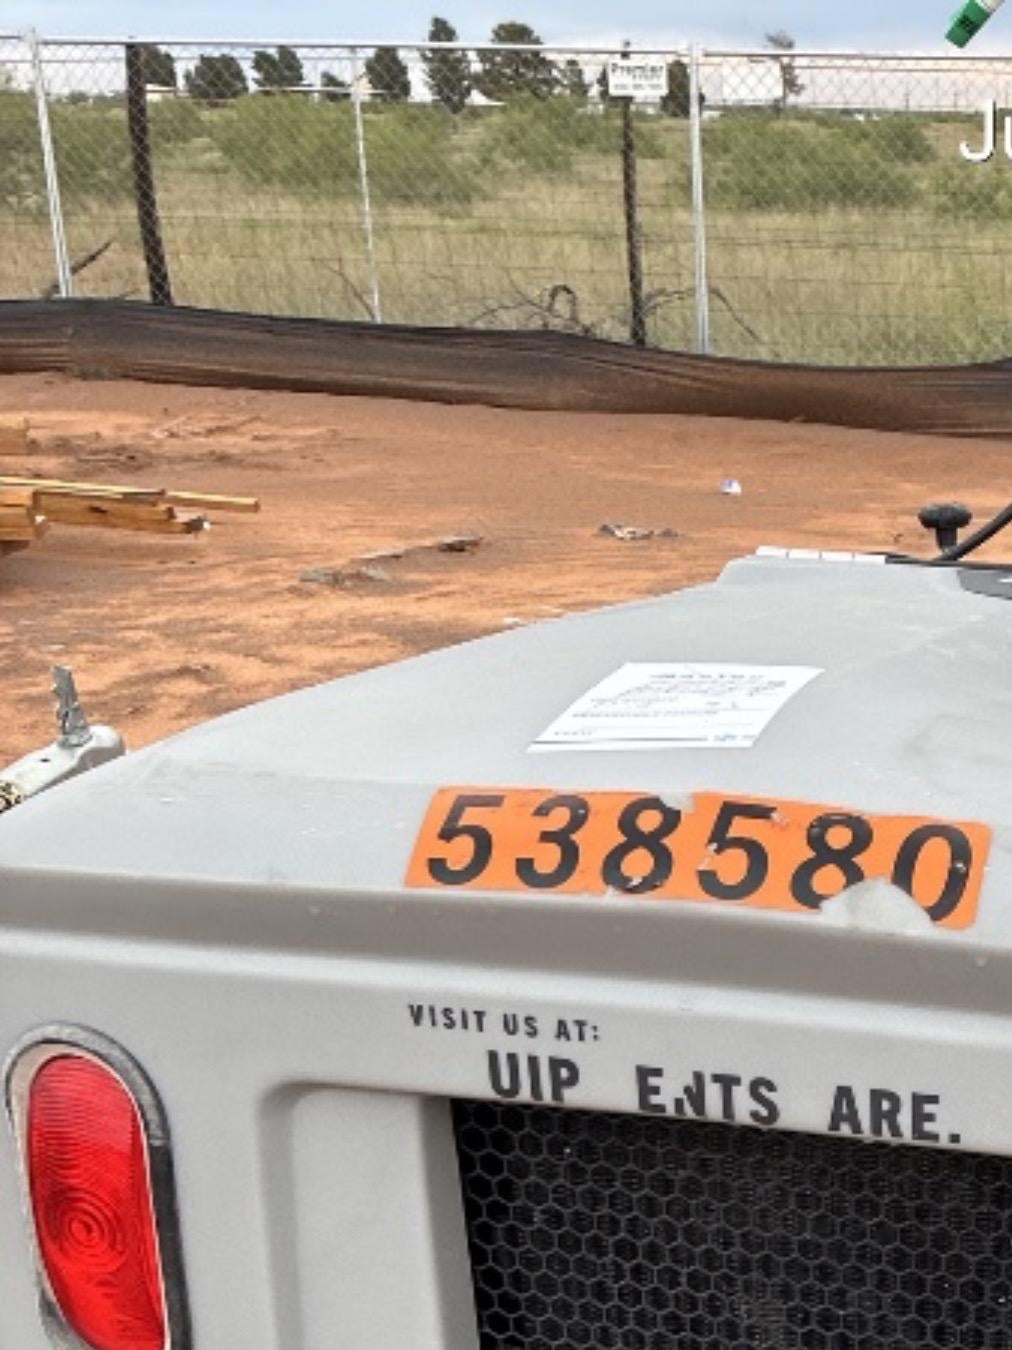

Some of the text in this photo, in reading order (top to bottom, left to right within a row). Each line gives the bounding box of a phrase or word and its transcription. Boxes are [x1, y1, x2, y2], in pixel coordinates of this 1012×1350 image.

[427, 794, 973, 922] 538580
[409, 1004, 600, 1042] VISIT US AT:
